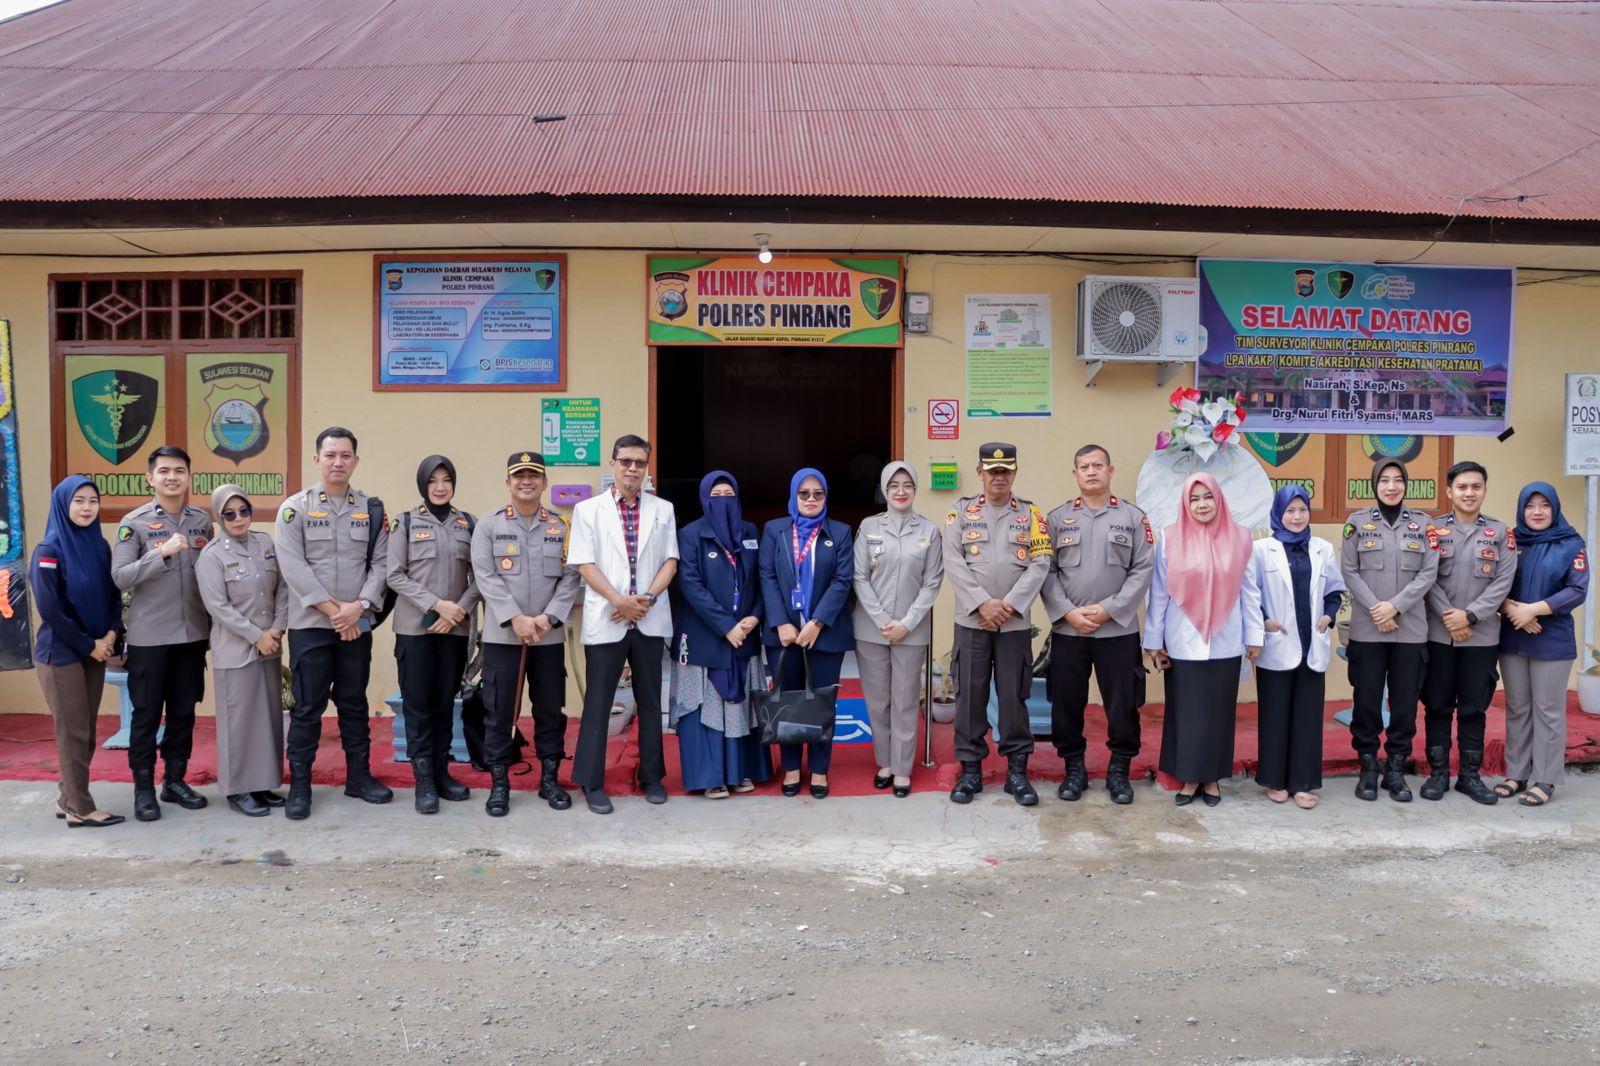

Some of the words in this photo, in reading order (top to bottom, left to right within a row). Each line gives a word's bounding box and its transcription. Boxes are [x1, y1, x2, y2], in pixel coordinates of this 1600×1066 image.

[697, 271, 758, 297] KLINIK
[763, 271, 852, 298] CEMPAKA
[697, 303, 766, 327] POLRES
[770, 304, 851, 328] PINRANG
[1242, 305, 1363, 330] SELAMAT
[1369, 308, 1471, 335] DATANG
[1236, 336, 1255, 349] TIM
[1257, 337, 1308, 350] SURVEYOR
[1310, 338, 1342, 350] KLINIK
[1345, 340, 1391, 352] CEMPAKA
[1394, 341, 1430, 353] POLRES
[1431, 342, 1475, 354] PINRANG
[495, 358, 513, 367] BPJS
[1225, 354, 1245, 366] LPA
[1247, 355, 1273, 367] KAKP
[1276, 355, 1316, 369] (KOMITE
[1318, 356, 1376, 369] AKREDITASI
[1377, 357, 1433, 370] KESEHATAN
[1435, 359, 1484, 374] PRATAMA)
[204, 366, 239, 379] SULAWESI
[239, 366, 270, 379] SELATAN
[1303, 379, 1350, 392] Nasirah,
[1352, 379, 1388, 393] S.Kep,
[1390, 380, 1406, 391] Ns
[1349, 395, 1360, 405] &
[1272, 409, 1296, 421] Drg.
[1298, 409, 1328, 420] Nurul
[1330, 409, 1354, 420] Fitri
[1356, 409, 1399, 423] Syamsi,
[1401, 411, 1434, 421] MARS
[234, 473, 283, 496] PINRANG
[1406, 479, 1436, 500] RANG
[1109, 524, 1133, 533] POLRI
